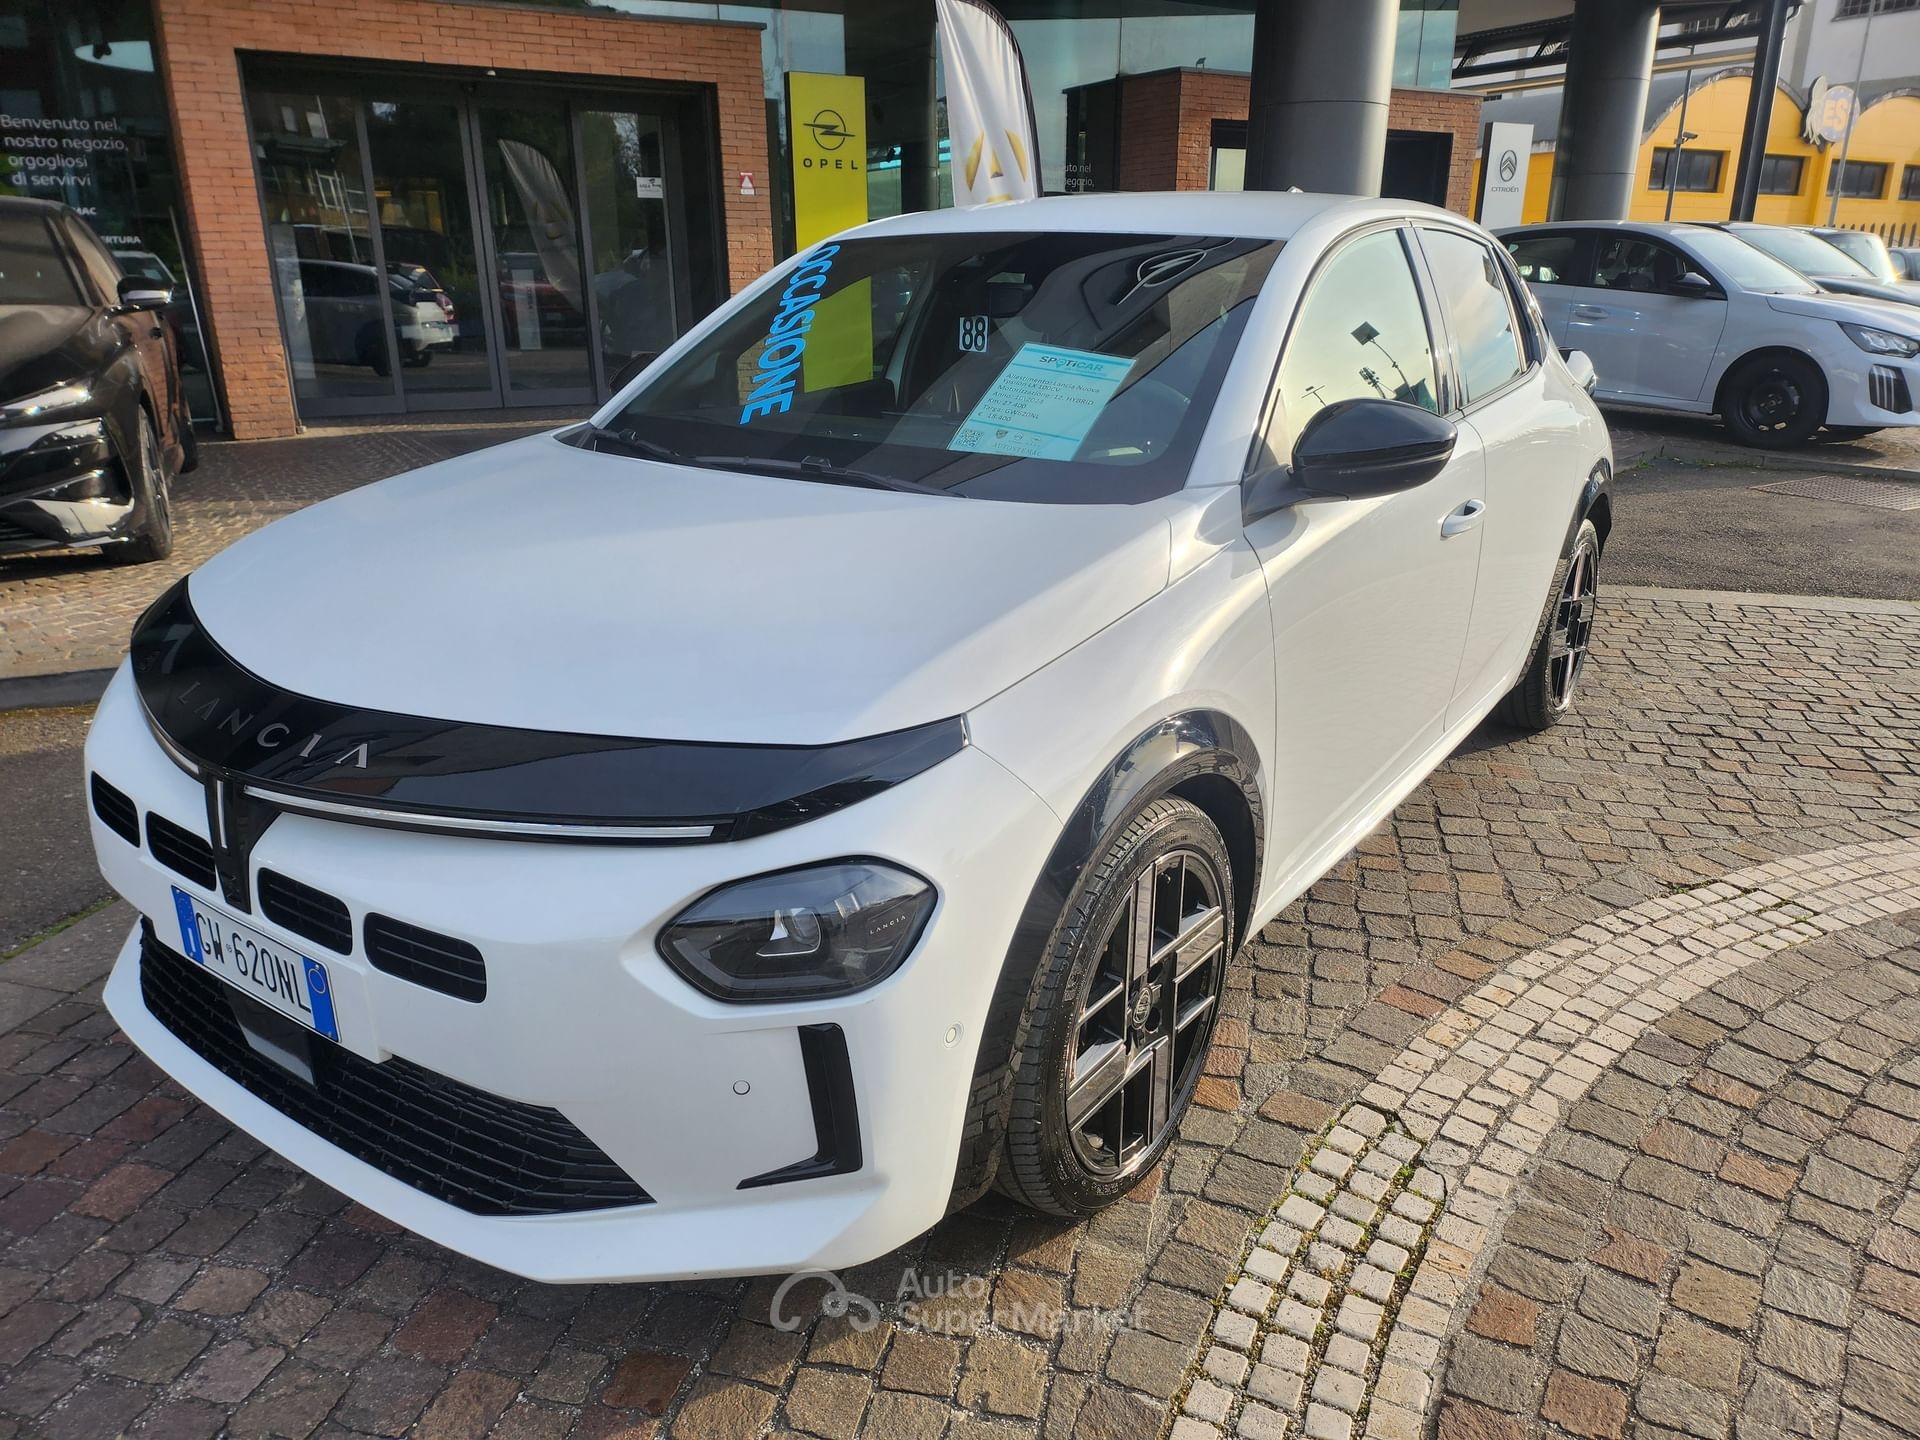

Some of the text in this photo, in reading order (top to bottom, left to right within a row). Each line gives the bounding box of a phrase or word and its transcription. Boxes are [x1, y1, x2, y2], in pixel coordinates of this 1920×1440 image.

[0, 114, 89, 131] Benvenuto
[1822, 98, 1849, 132] ES
[4, 135, 128, 152] nostro negozio,
[8, 154, 88, 170] orgogliosi
[803, 158, 858, 170] OPEL
[12, 171, 91, 186] di servirvi
[739, 242, 841, 425] OCCASIONE
[962, 316, 987, 351] 88
[176, 680, 369, 770] LANCIA
[869, 914, 907, 935] LANCIA
